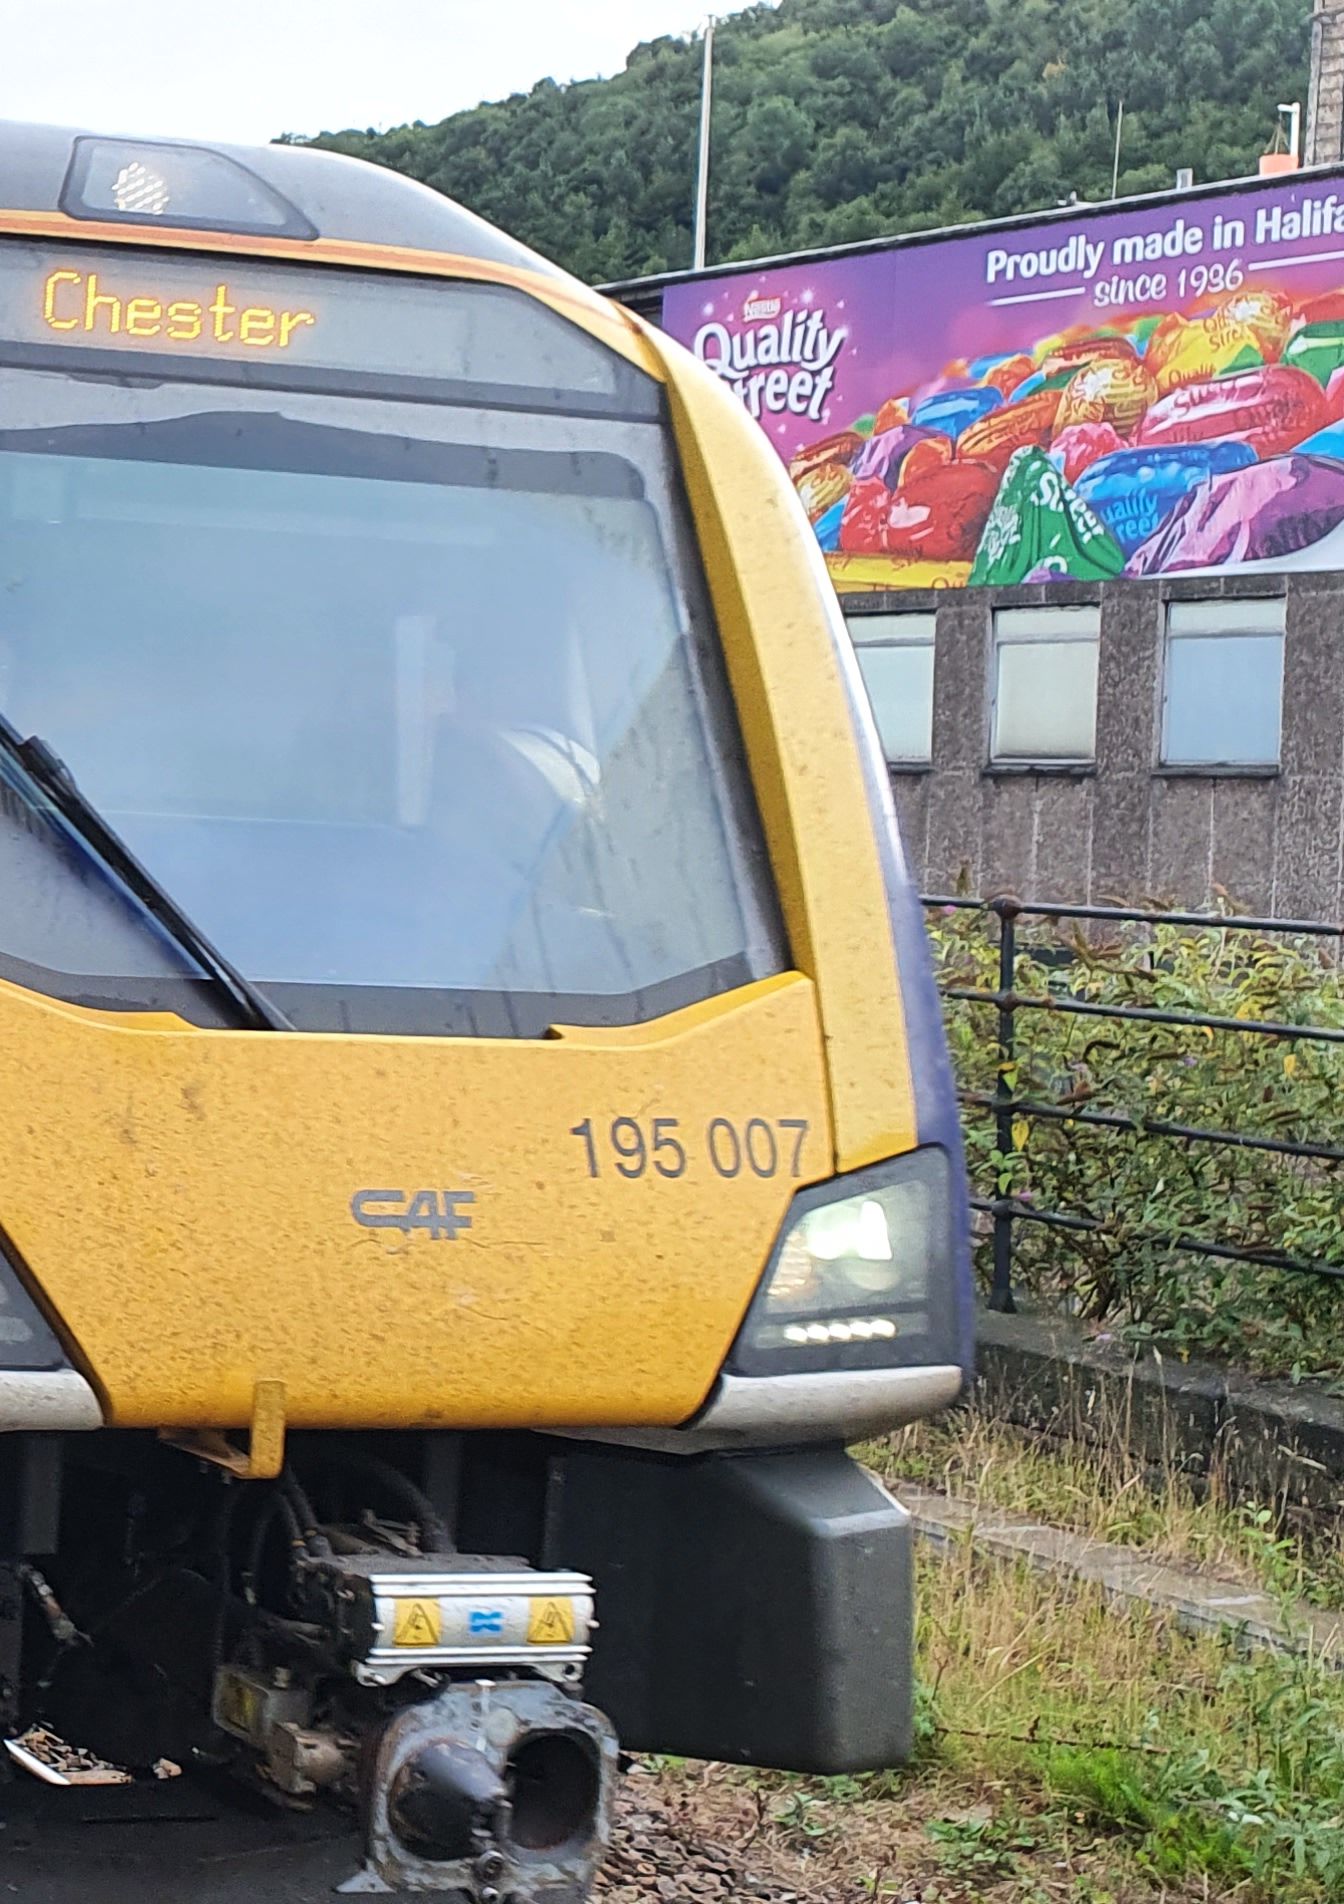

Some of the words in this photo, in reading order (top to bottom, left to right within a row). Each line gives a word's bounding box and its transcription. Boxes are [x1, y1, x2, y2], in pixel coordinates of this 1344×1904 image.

[986, 234, 1105, 283] Proudly
[1112, 219, 1203, 265] made
[1213, 215, 1245, 250] in
[1255, 195, 1344, 244] Halifa
[43, 270, 315, 348] Chester
[1093, 274, 1167, 307] since
[694, 309, 849, 379] Quality
[733, 366, 834, 420] treet
[570, 1117, 687, 1178] 195
[708, 1117, 810, 1179] 007
[351, 1189, 475, 1240] CAF
